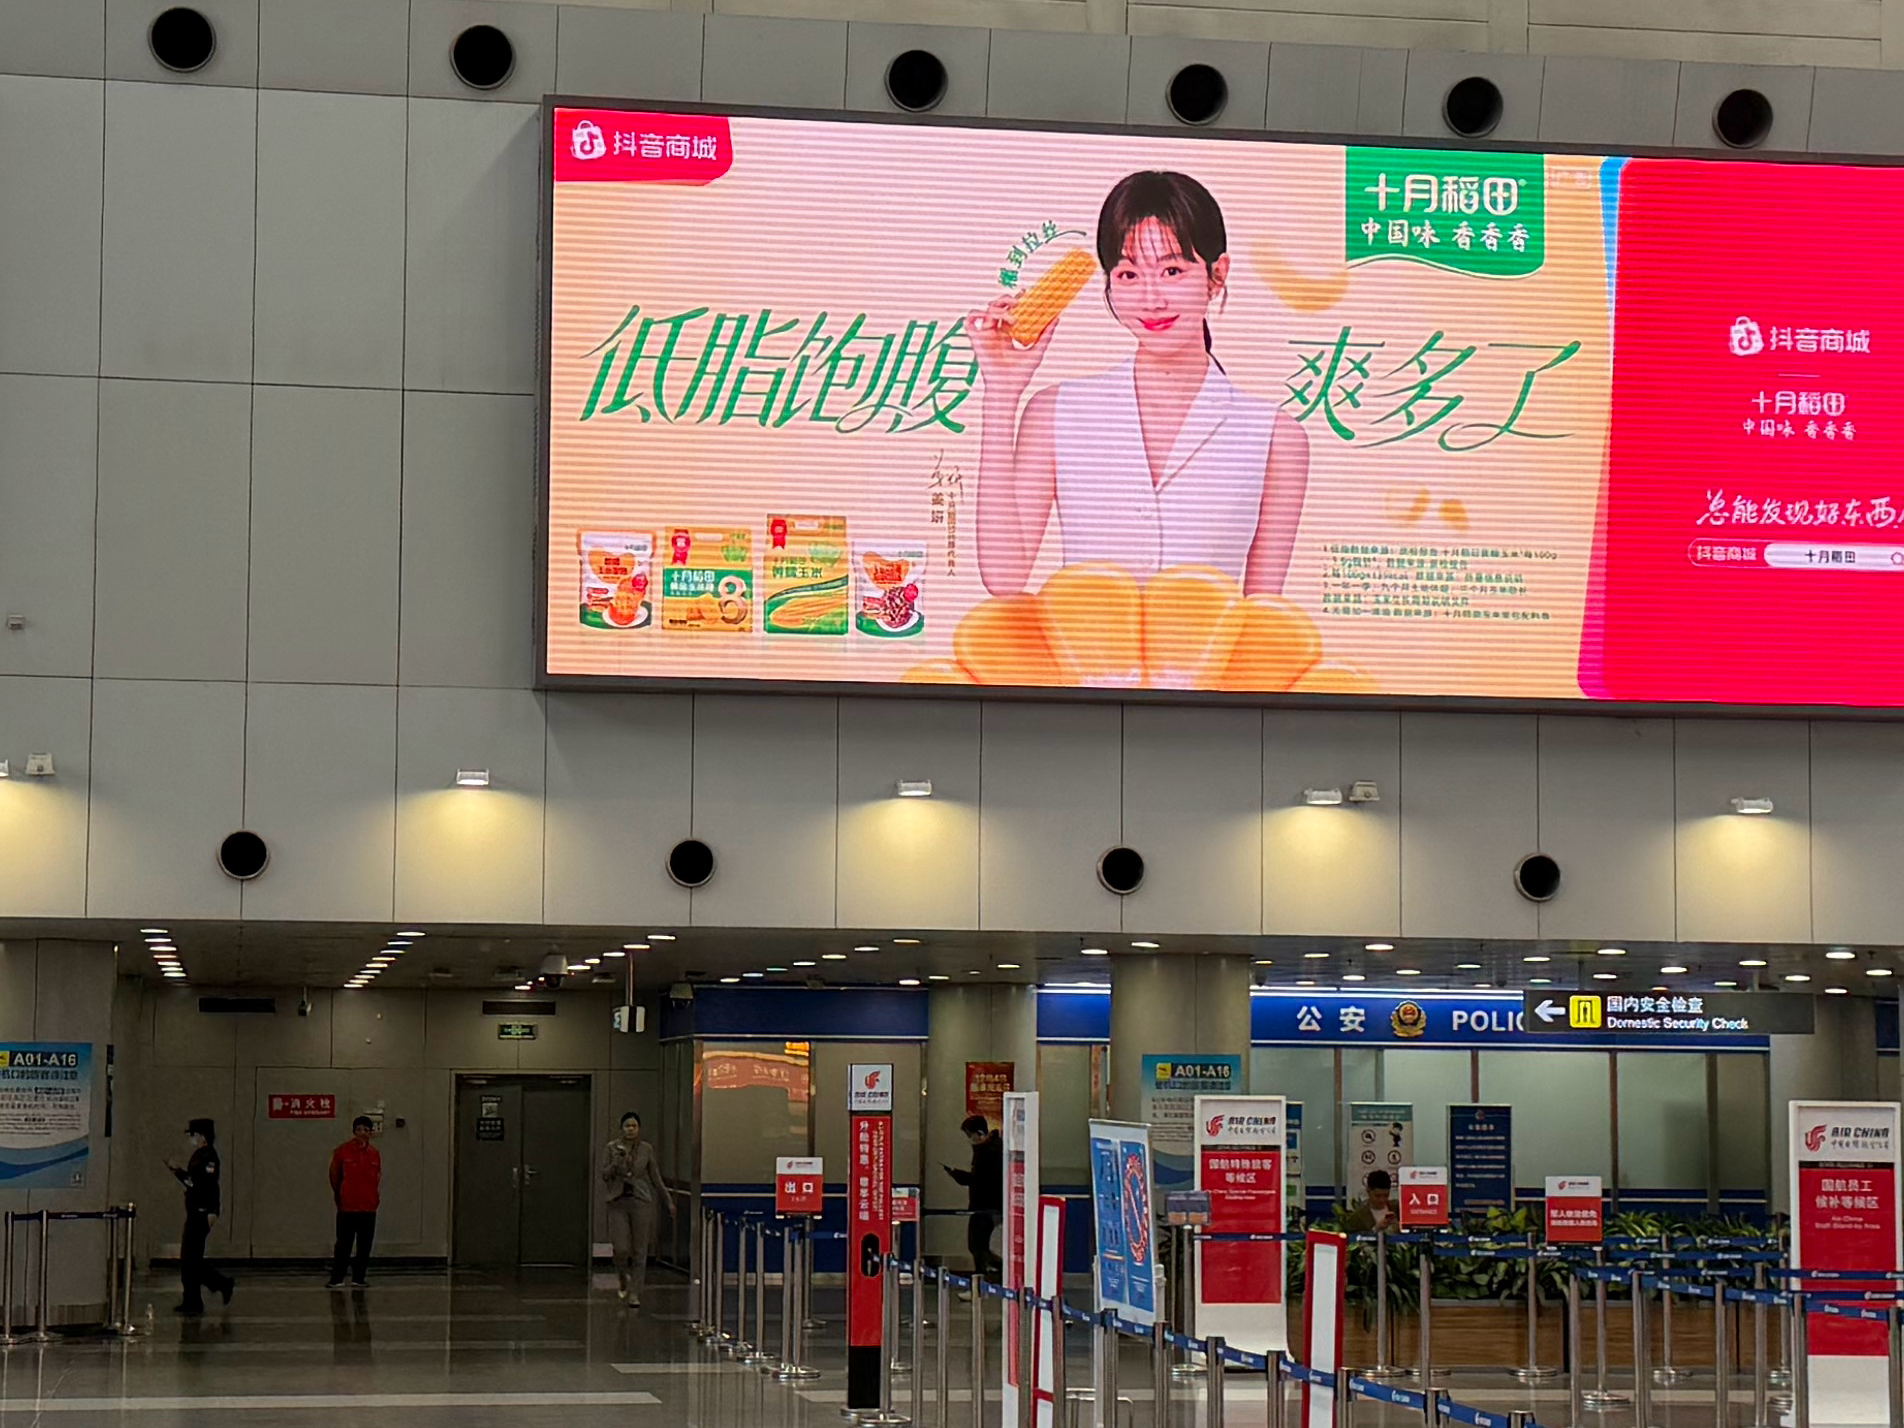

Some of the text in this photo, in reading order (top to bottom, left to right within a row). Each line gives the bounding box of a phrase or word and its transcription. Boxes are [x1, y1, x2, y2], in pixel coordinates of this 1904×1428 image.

[613, 131, 717, 160] 抖音商城
[1364, 173, 1520, 216] 十月稻田
[1361, 217, 1530, 252] 中国味 香香香
[1770, 326, 1871, 353] 抖音商城
[579, 305, 1581, 453] 低脂饱腹 爽多了
[1752, 391, 1845, 416] 十月稻田
[1742, 418, 1795, 437] 中国味
[1697, 545, 1856, 564] 抖音商城 十月稻田
[1607, 996, 1704, 1014] 国内安全检查
[1296, 1005, 1365, 1033] 公安
[1607, 1017, 1748, 1032] Domestic Security Check
[13, 1053, 77, 1066] A01-A16
[1175, 1065, 1230, 1077] A01-A16
[1409, 1193, 1439, 1205] 入口
